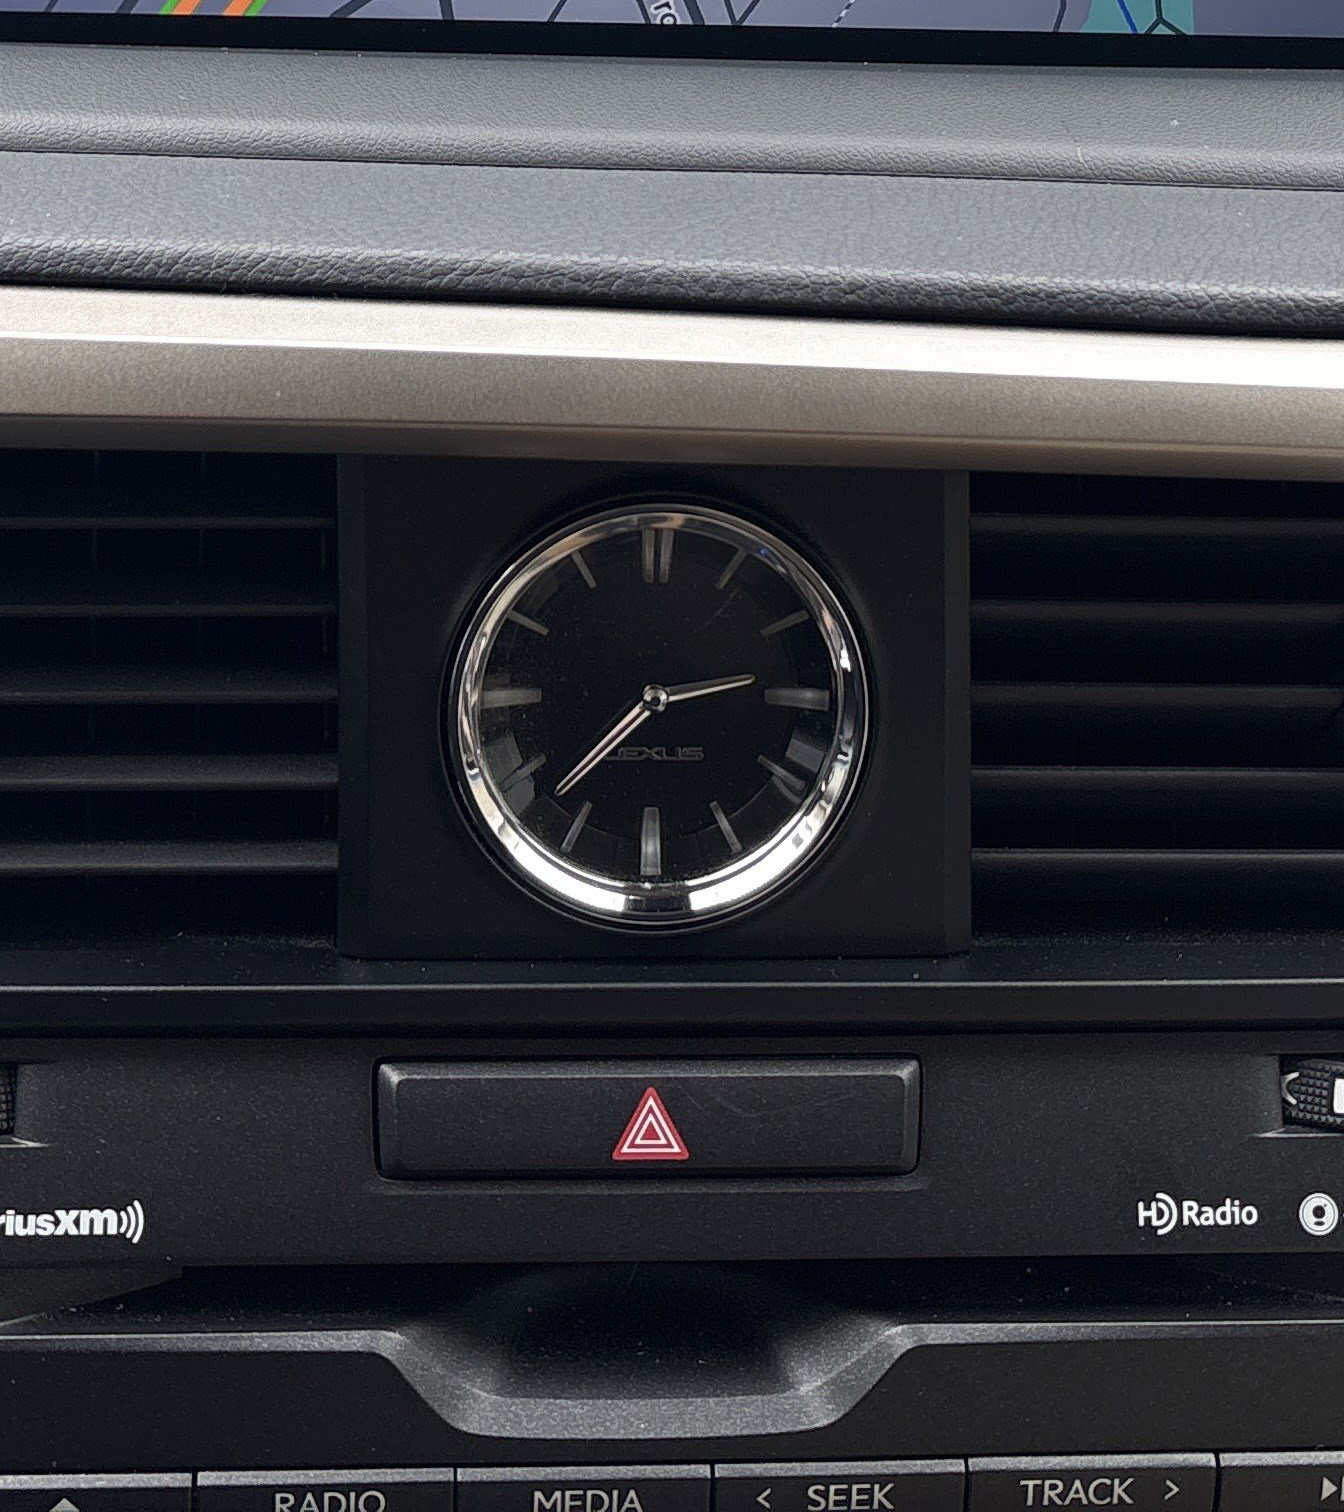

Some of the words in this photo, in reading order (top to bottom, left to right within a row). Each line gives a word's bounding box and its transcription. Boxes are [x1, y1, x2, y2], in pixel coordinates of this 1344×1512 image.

[1181, 1197, 1259, 1227] Radio
[273, 1489, 387, 1512] RADIO
[532, 1488, 646, 1512] MEDIA
[805, 1482, 897, 1512] SEEK
[1018, 1476, 1136, 1508] TRACK
